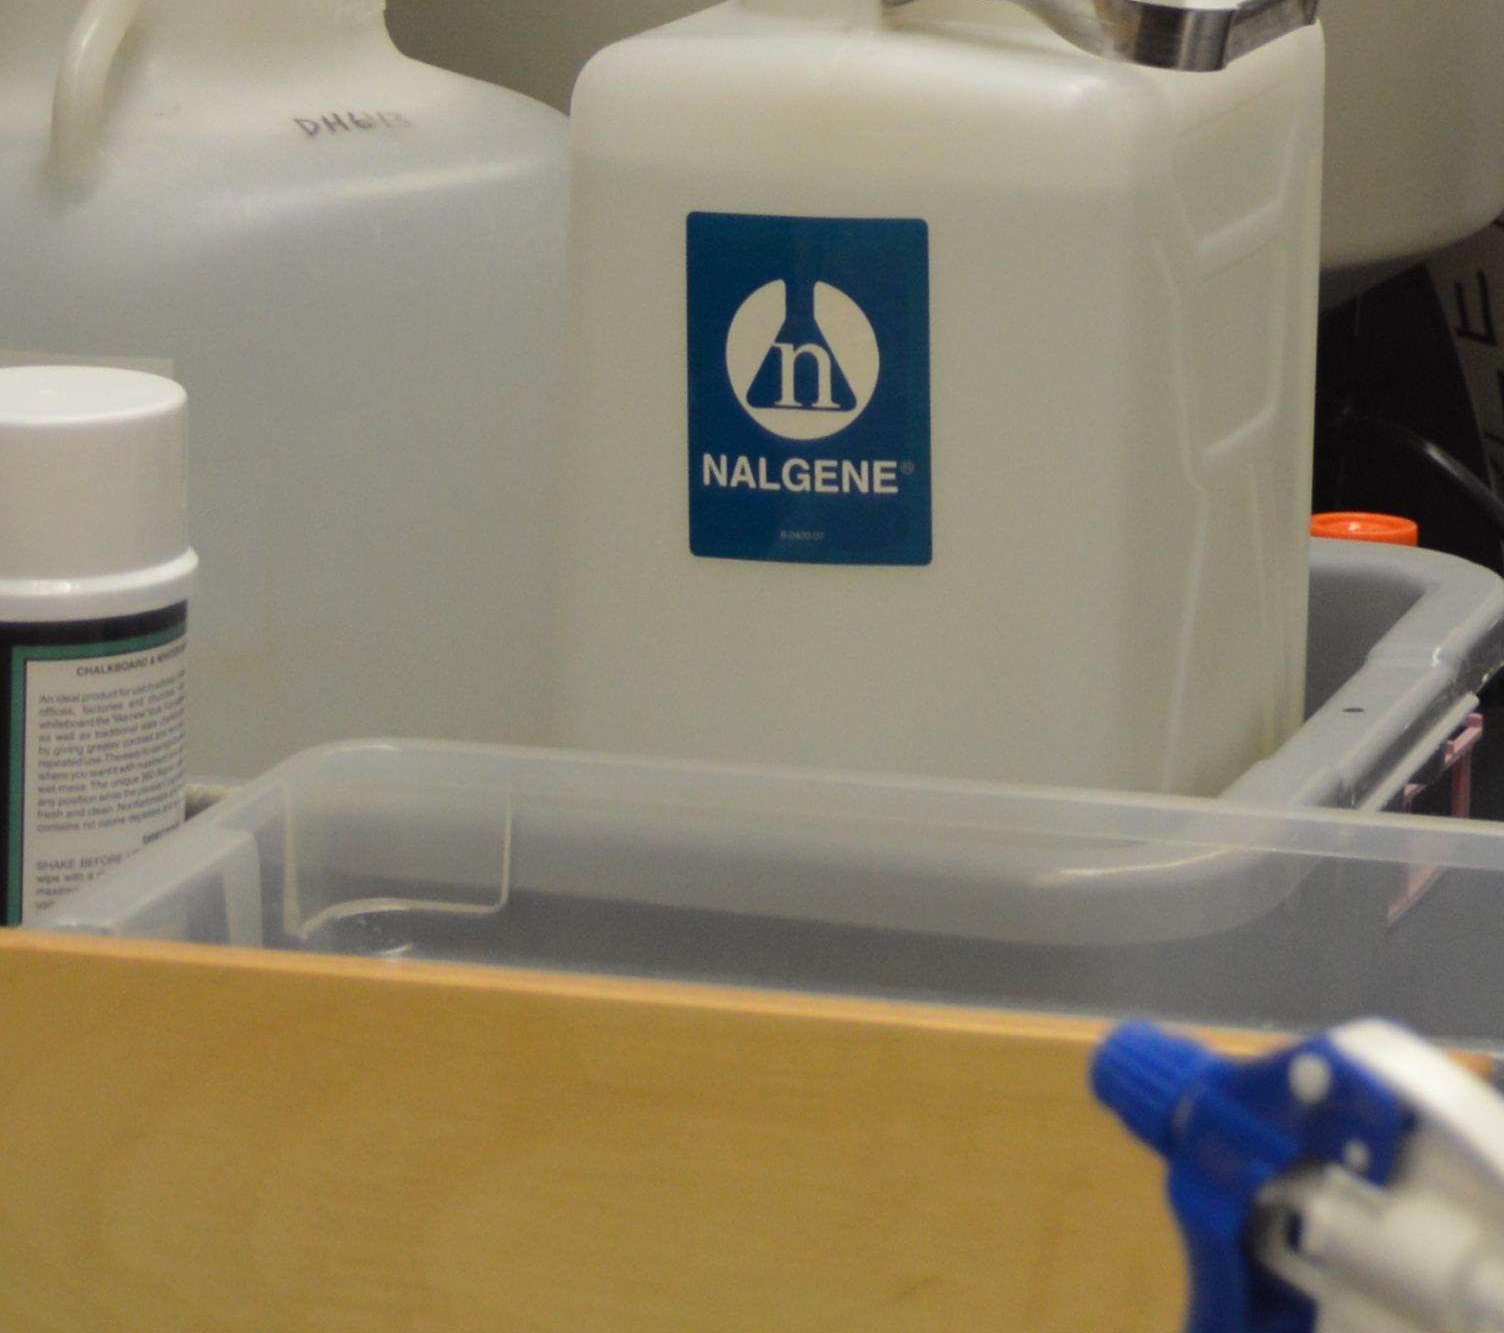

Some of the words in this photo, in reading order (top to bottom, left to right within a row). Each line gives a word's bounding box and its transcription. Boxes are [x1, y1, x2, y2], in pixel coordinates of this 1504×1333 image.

[702, 452, 899, 494] NALGENE
[76, 657, 148, 677] CHALKBOARD
[36, 859, 75, 871] SHAKE
